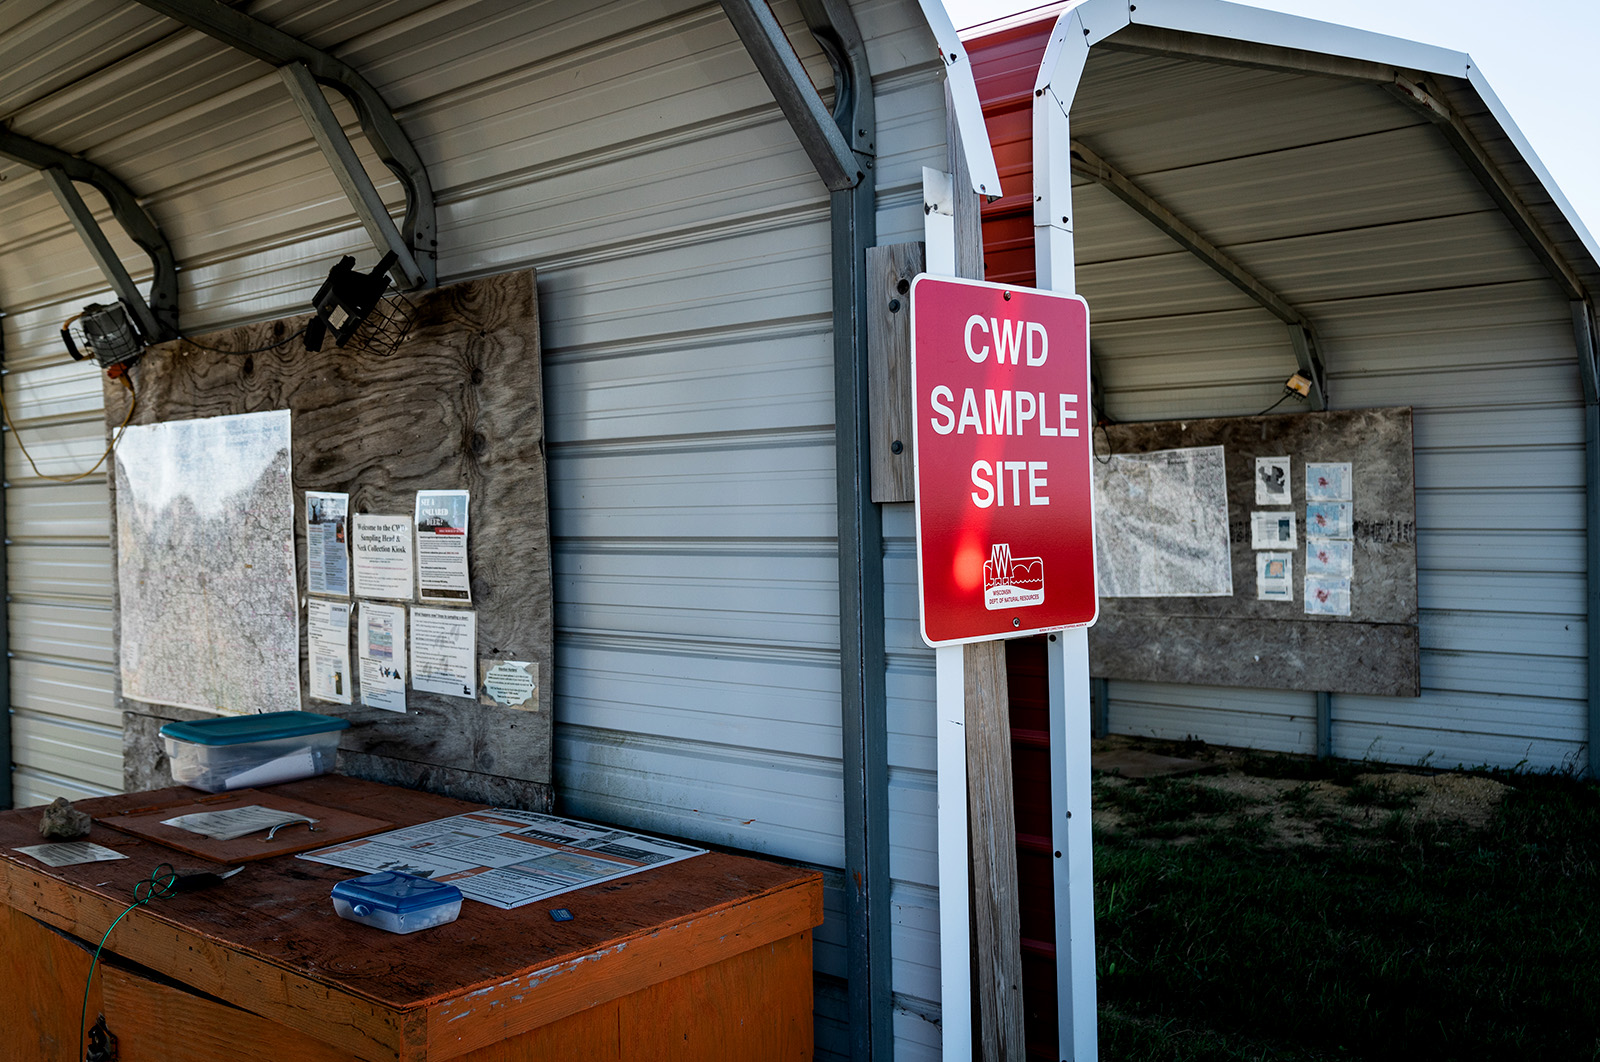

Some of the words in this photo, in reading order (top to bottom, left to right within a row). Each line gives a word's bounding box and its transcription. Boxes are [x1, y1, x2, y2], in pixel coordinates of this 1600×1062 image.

[964, 314, 1049, 367] CWD
[930, 385, 1080, 438] SAMPLE
[971, 459, 1050, 509] SITE
[357, 523, 376, 531] Welcome
[360, 534, 381, 543] Sampling
[382, 534, 395, 543] Head
[396, 535, 401, 543] &
[367, 544, 391, 553] Collection
